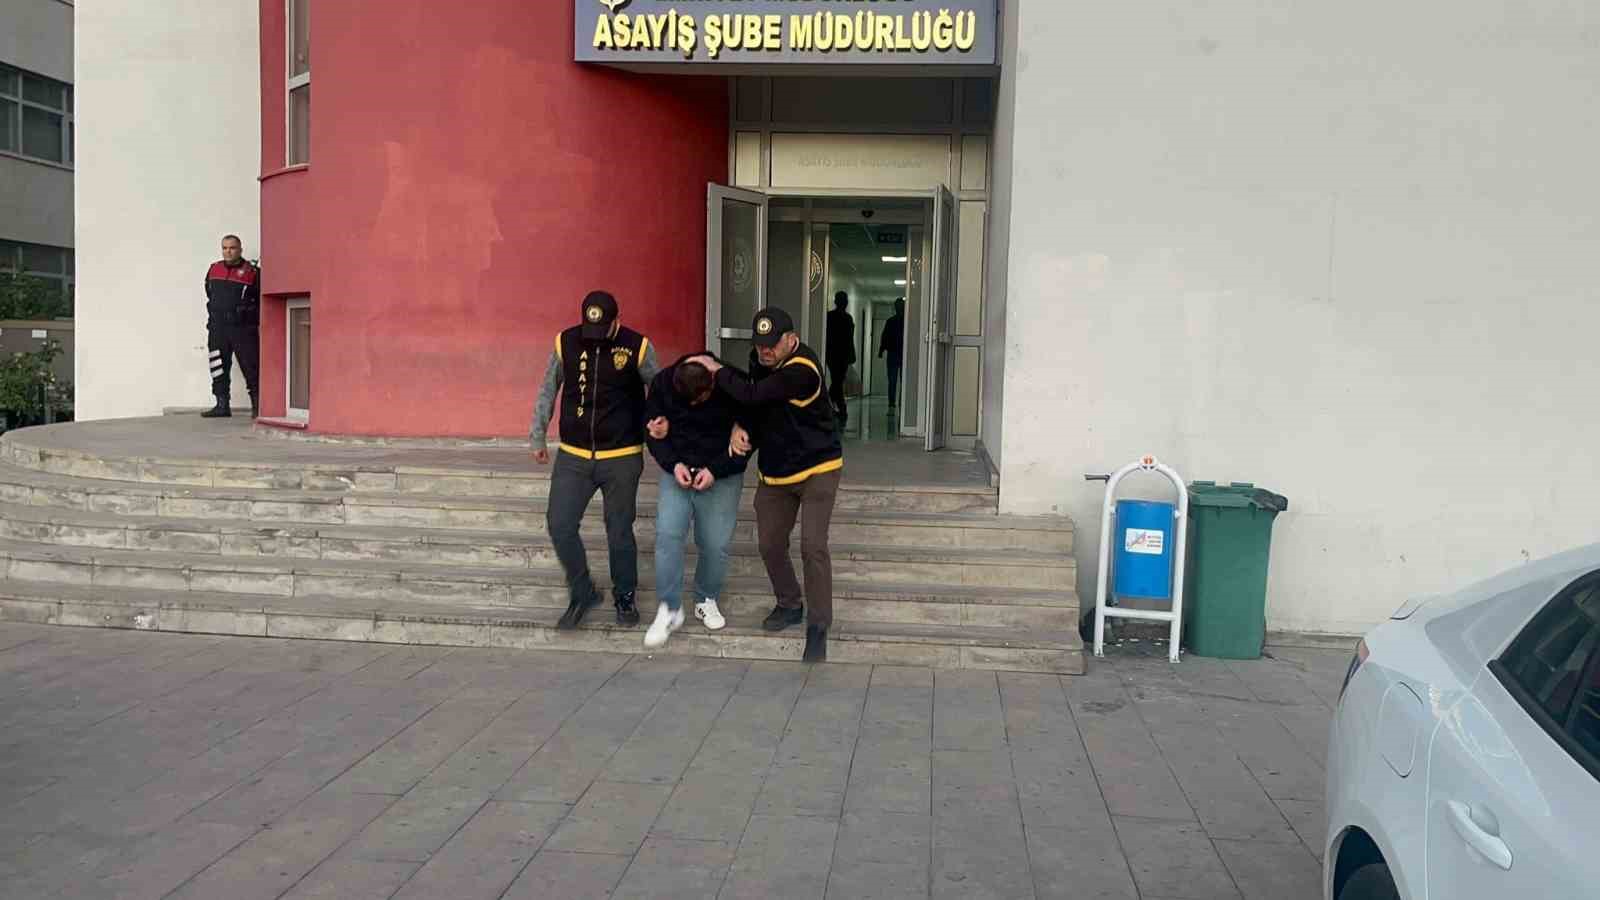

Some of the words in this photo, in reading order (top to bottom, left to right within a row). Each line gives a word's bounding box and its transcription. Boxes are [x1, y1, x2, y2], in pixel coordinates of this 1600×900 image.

[592, 8, 697, 57] ASAYİŞ
[703, 14, 782, 57] ŞUBE
[789, 8, 976, 52] MÜDÜRLÜĞÜ
